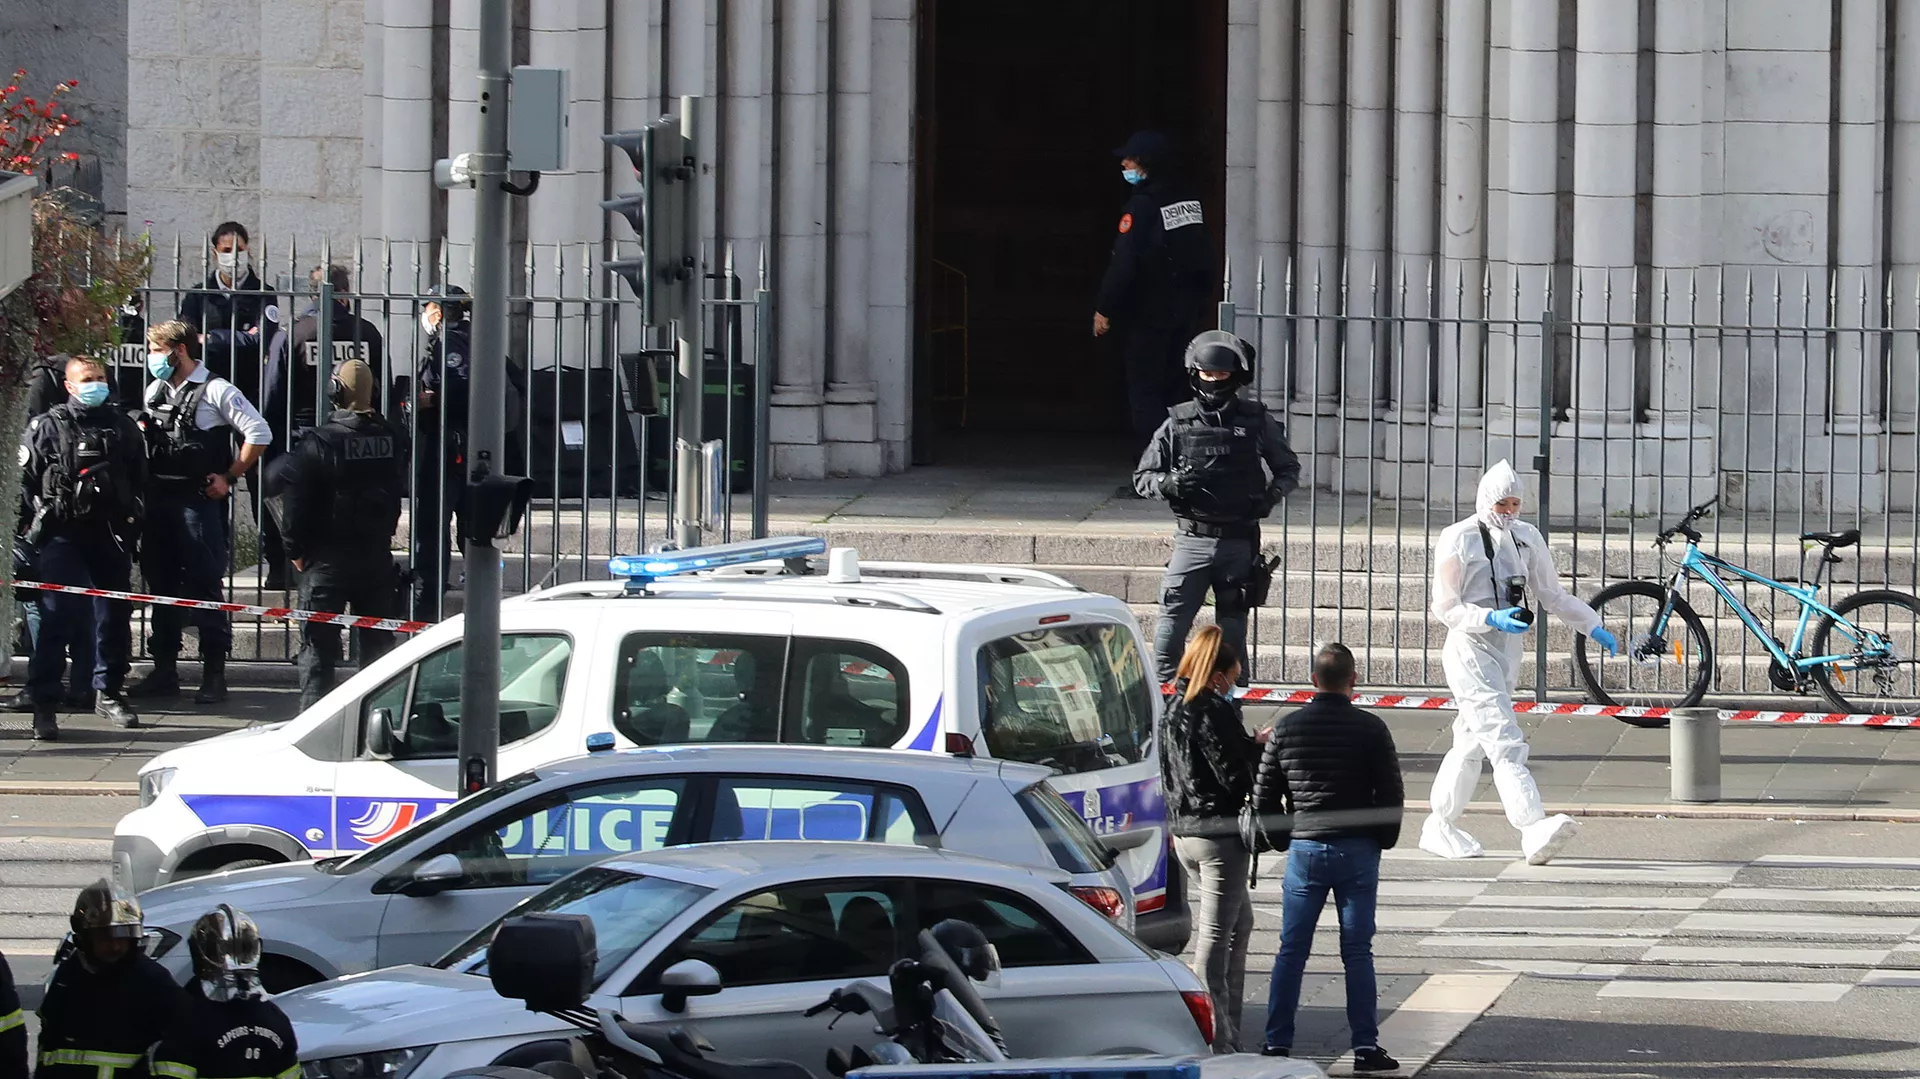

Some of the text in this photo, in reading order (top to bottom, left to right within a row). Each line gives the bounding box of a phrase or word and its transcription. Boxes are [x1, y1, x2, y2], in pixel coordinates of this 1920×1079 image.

[311, 344, 365, 361] PLICE
[348, 437, 391, 458] RAID
[438, 803, 676, 851] OLICE
[1086, 815, 1115, 835] ICE
